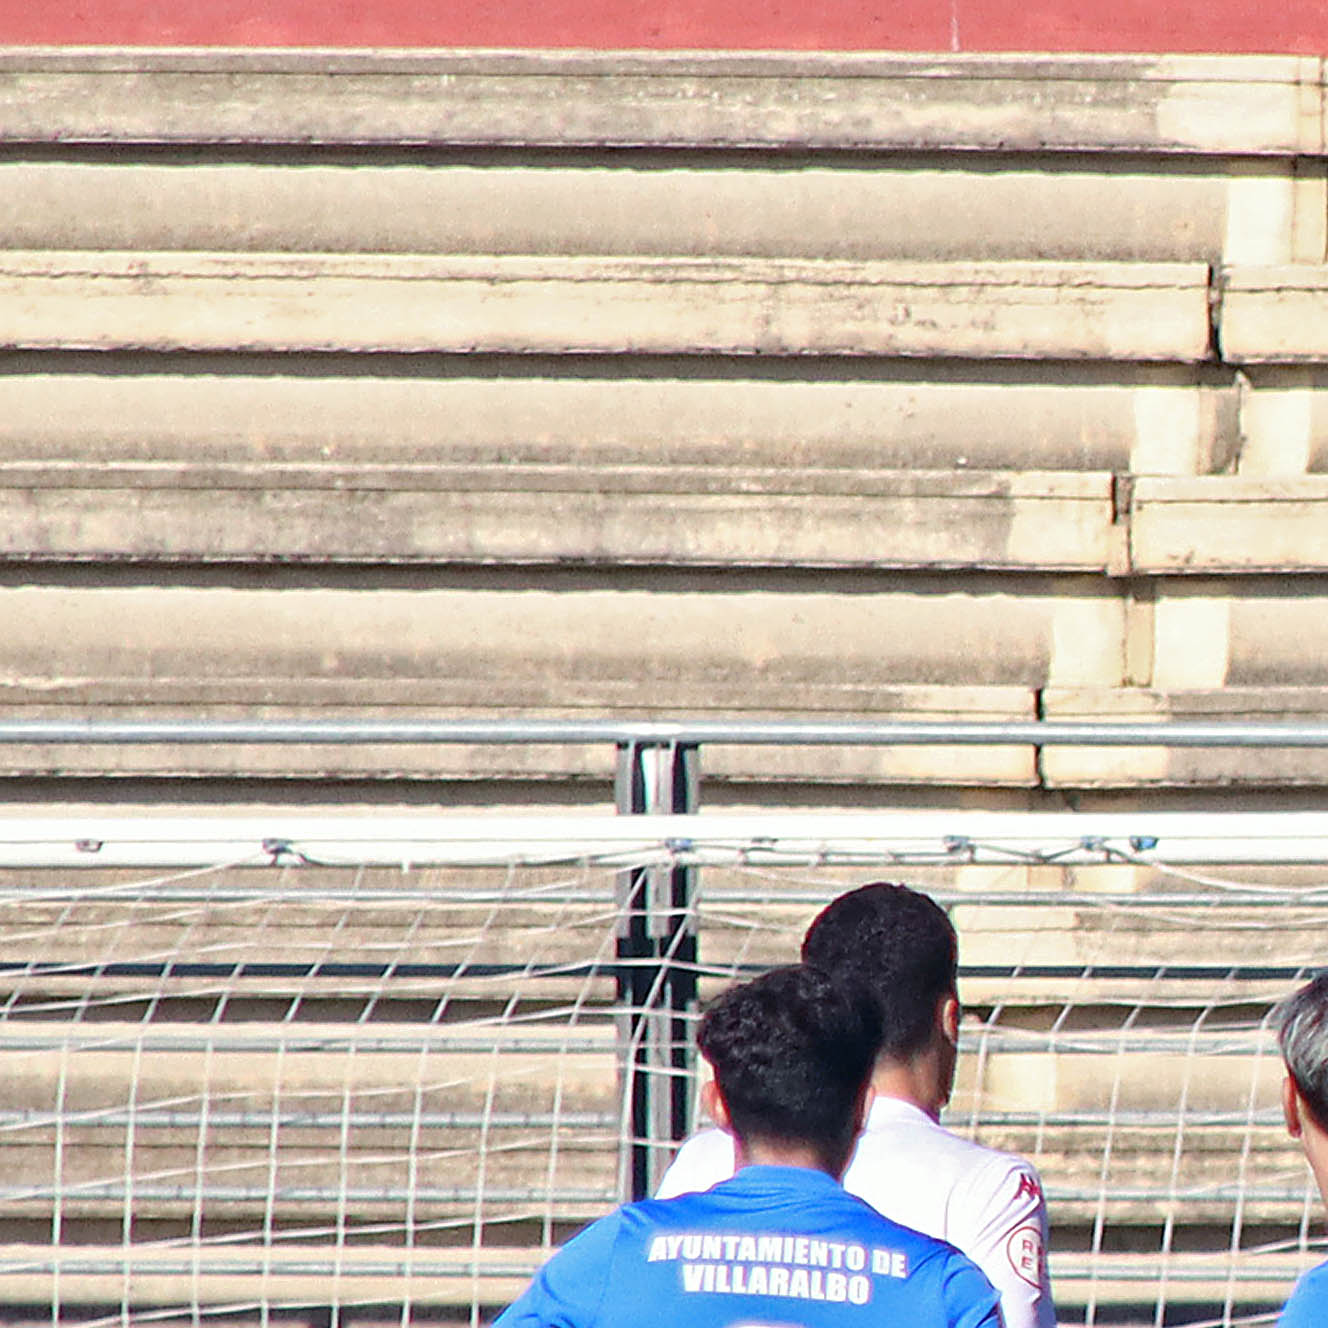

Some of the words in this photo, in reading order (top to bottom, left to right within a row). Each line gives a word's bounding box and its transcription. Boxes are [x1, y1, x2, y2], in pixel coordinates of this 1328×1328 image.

[647, 1234, 866, 1272] AYUNTAMIENTO
[872, 1248, 907, 1279] DE
[682, 1263, 871, 1305] VILLARALBO
